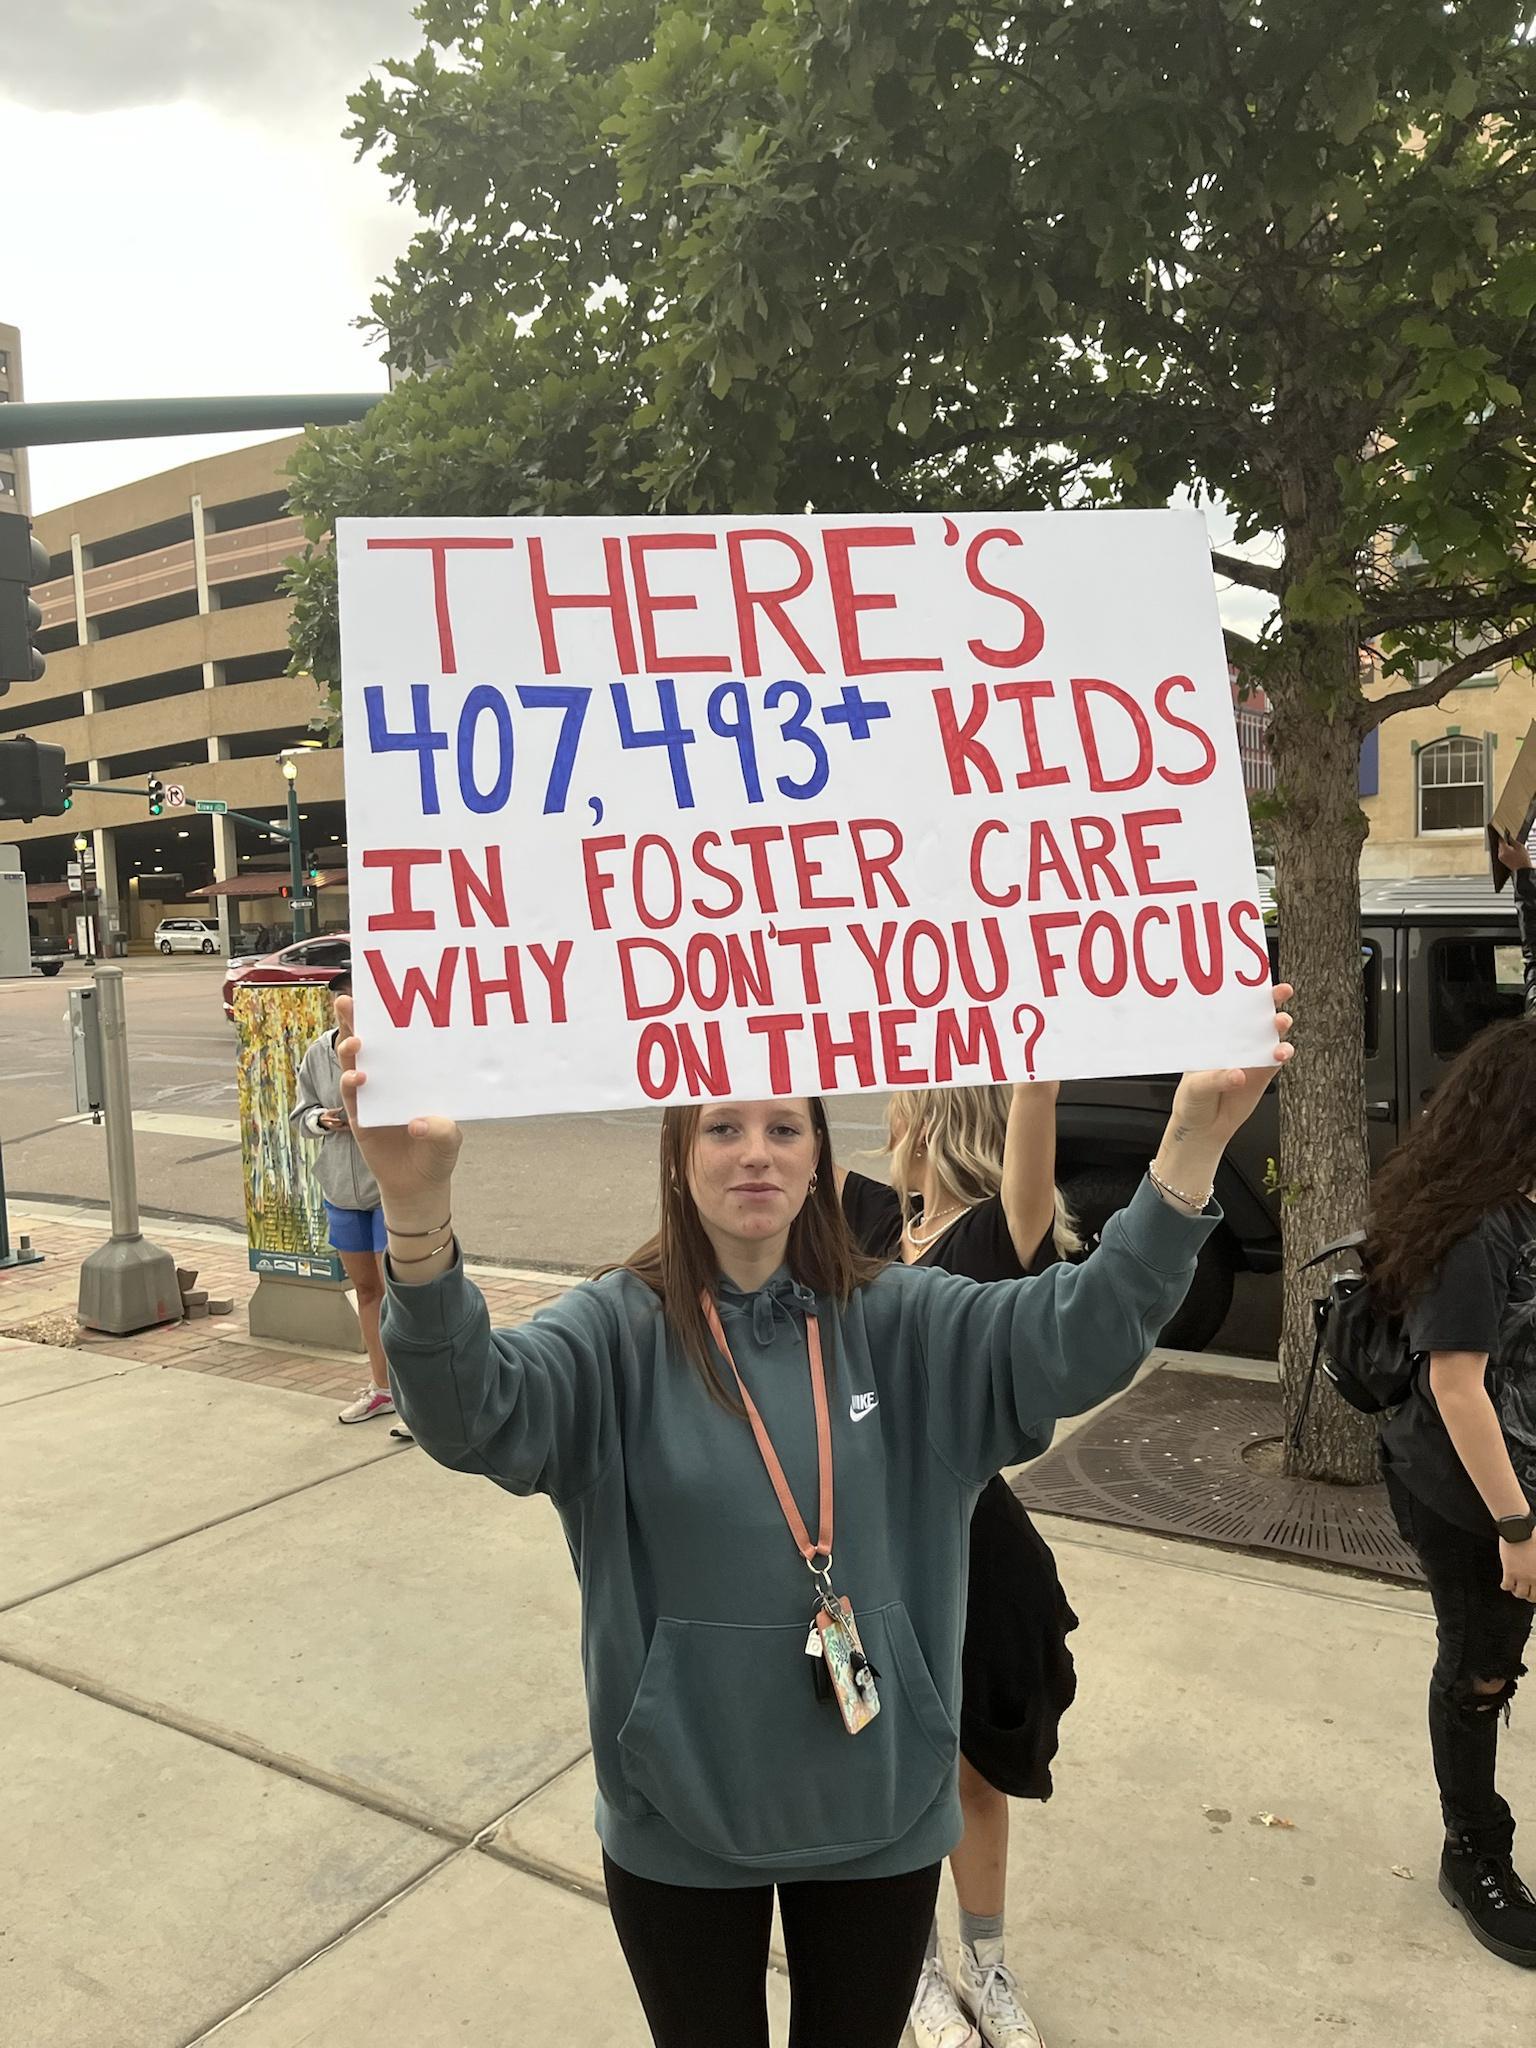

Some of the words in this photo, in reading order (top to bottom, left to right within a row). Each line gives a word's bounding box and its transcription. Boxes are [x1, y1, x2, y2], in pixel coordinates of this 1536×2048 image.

[366, 516, 1045, 678] THERE'S
[364, 679, 891, 826] 407,493+
[931, 675, 1217, 795] KIDS
[362, 844, 510, 932] IN
[581, 818, 910, 931] FOSTER
[969, 807, 1198, 909] CARE
[363, 939, 574, 1029] WHY
[616, 920, 832, 1021] DON'T
[847, 916, 1010, 1009] YOU
[1029, 900, 1270, 999] FOCUS
[636, 1020, 732, 1100] ON
[747, 1003, 1046, 1096] THEM?
[851, 1391, 875, 1411] NIKE
